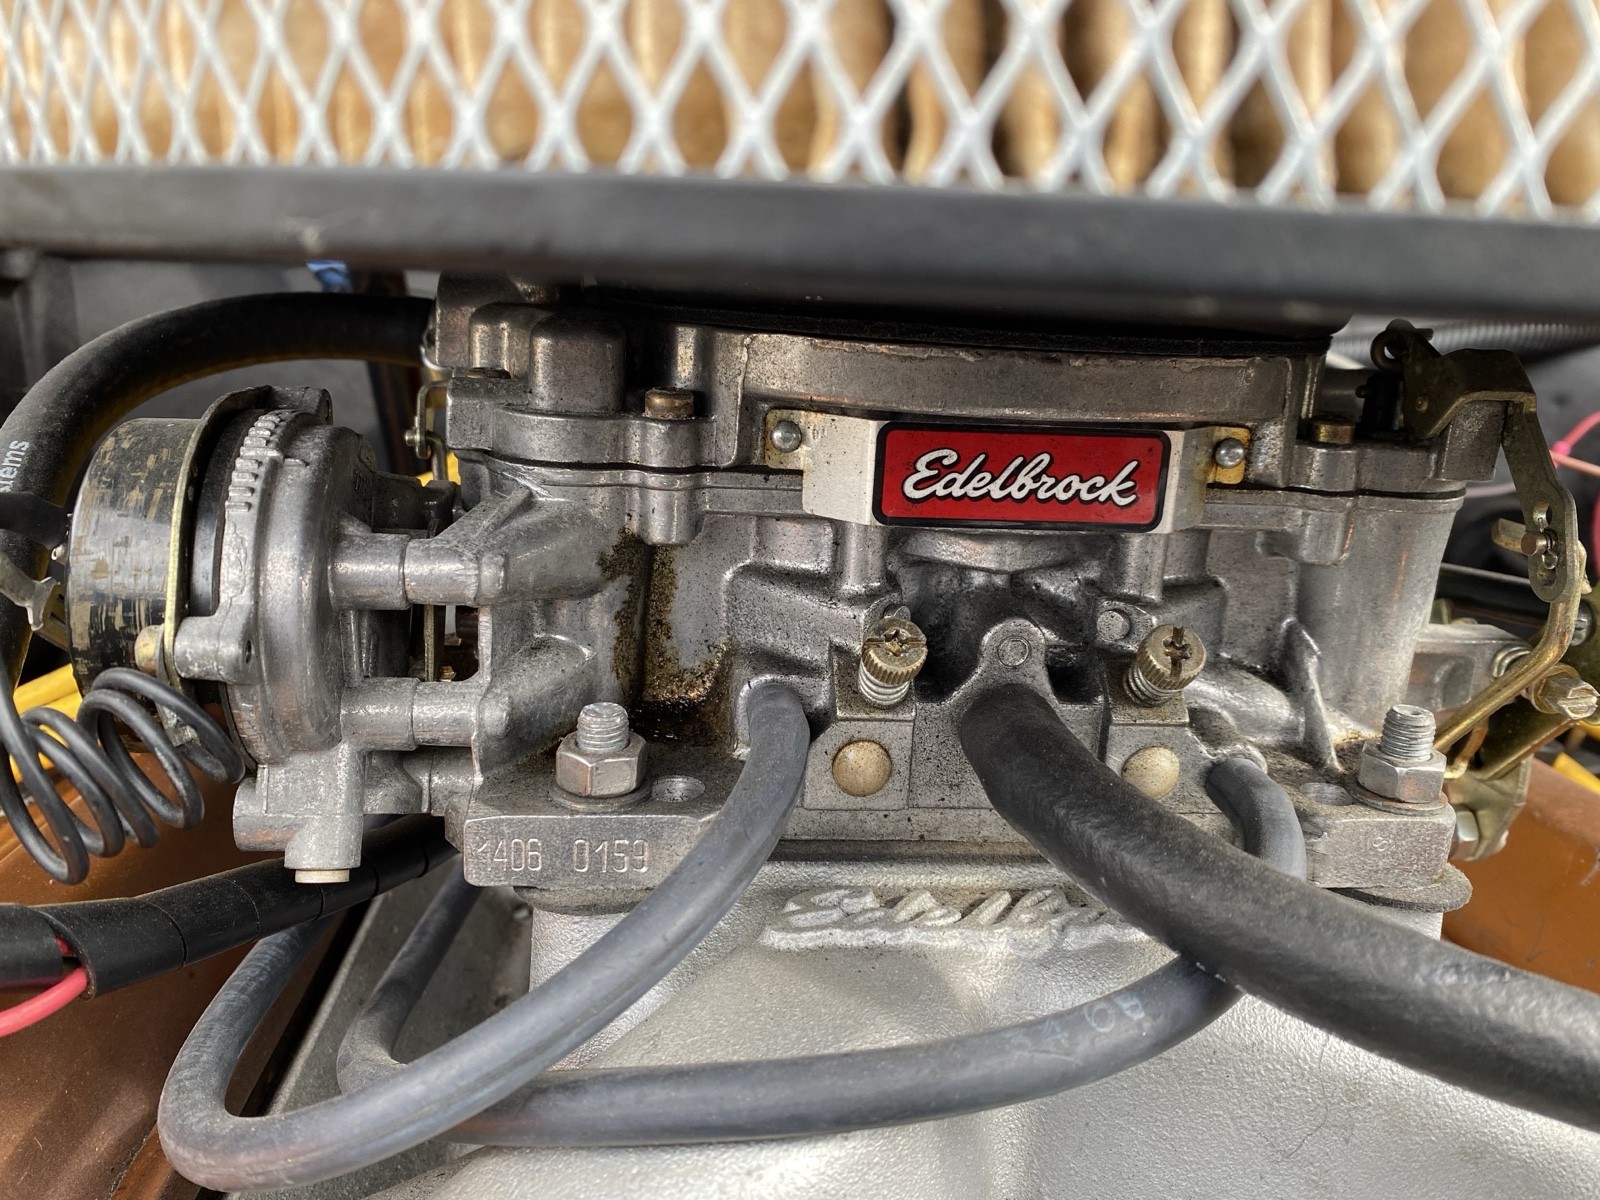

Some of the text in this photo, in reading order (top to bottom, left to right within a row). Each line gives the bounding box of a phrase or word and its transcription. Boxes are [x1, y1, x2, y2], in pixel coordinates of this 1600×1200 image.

[902, 448, 1139, 507] Edelbrock
[477, 838, 649, 873] 1406 0159
